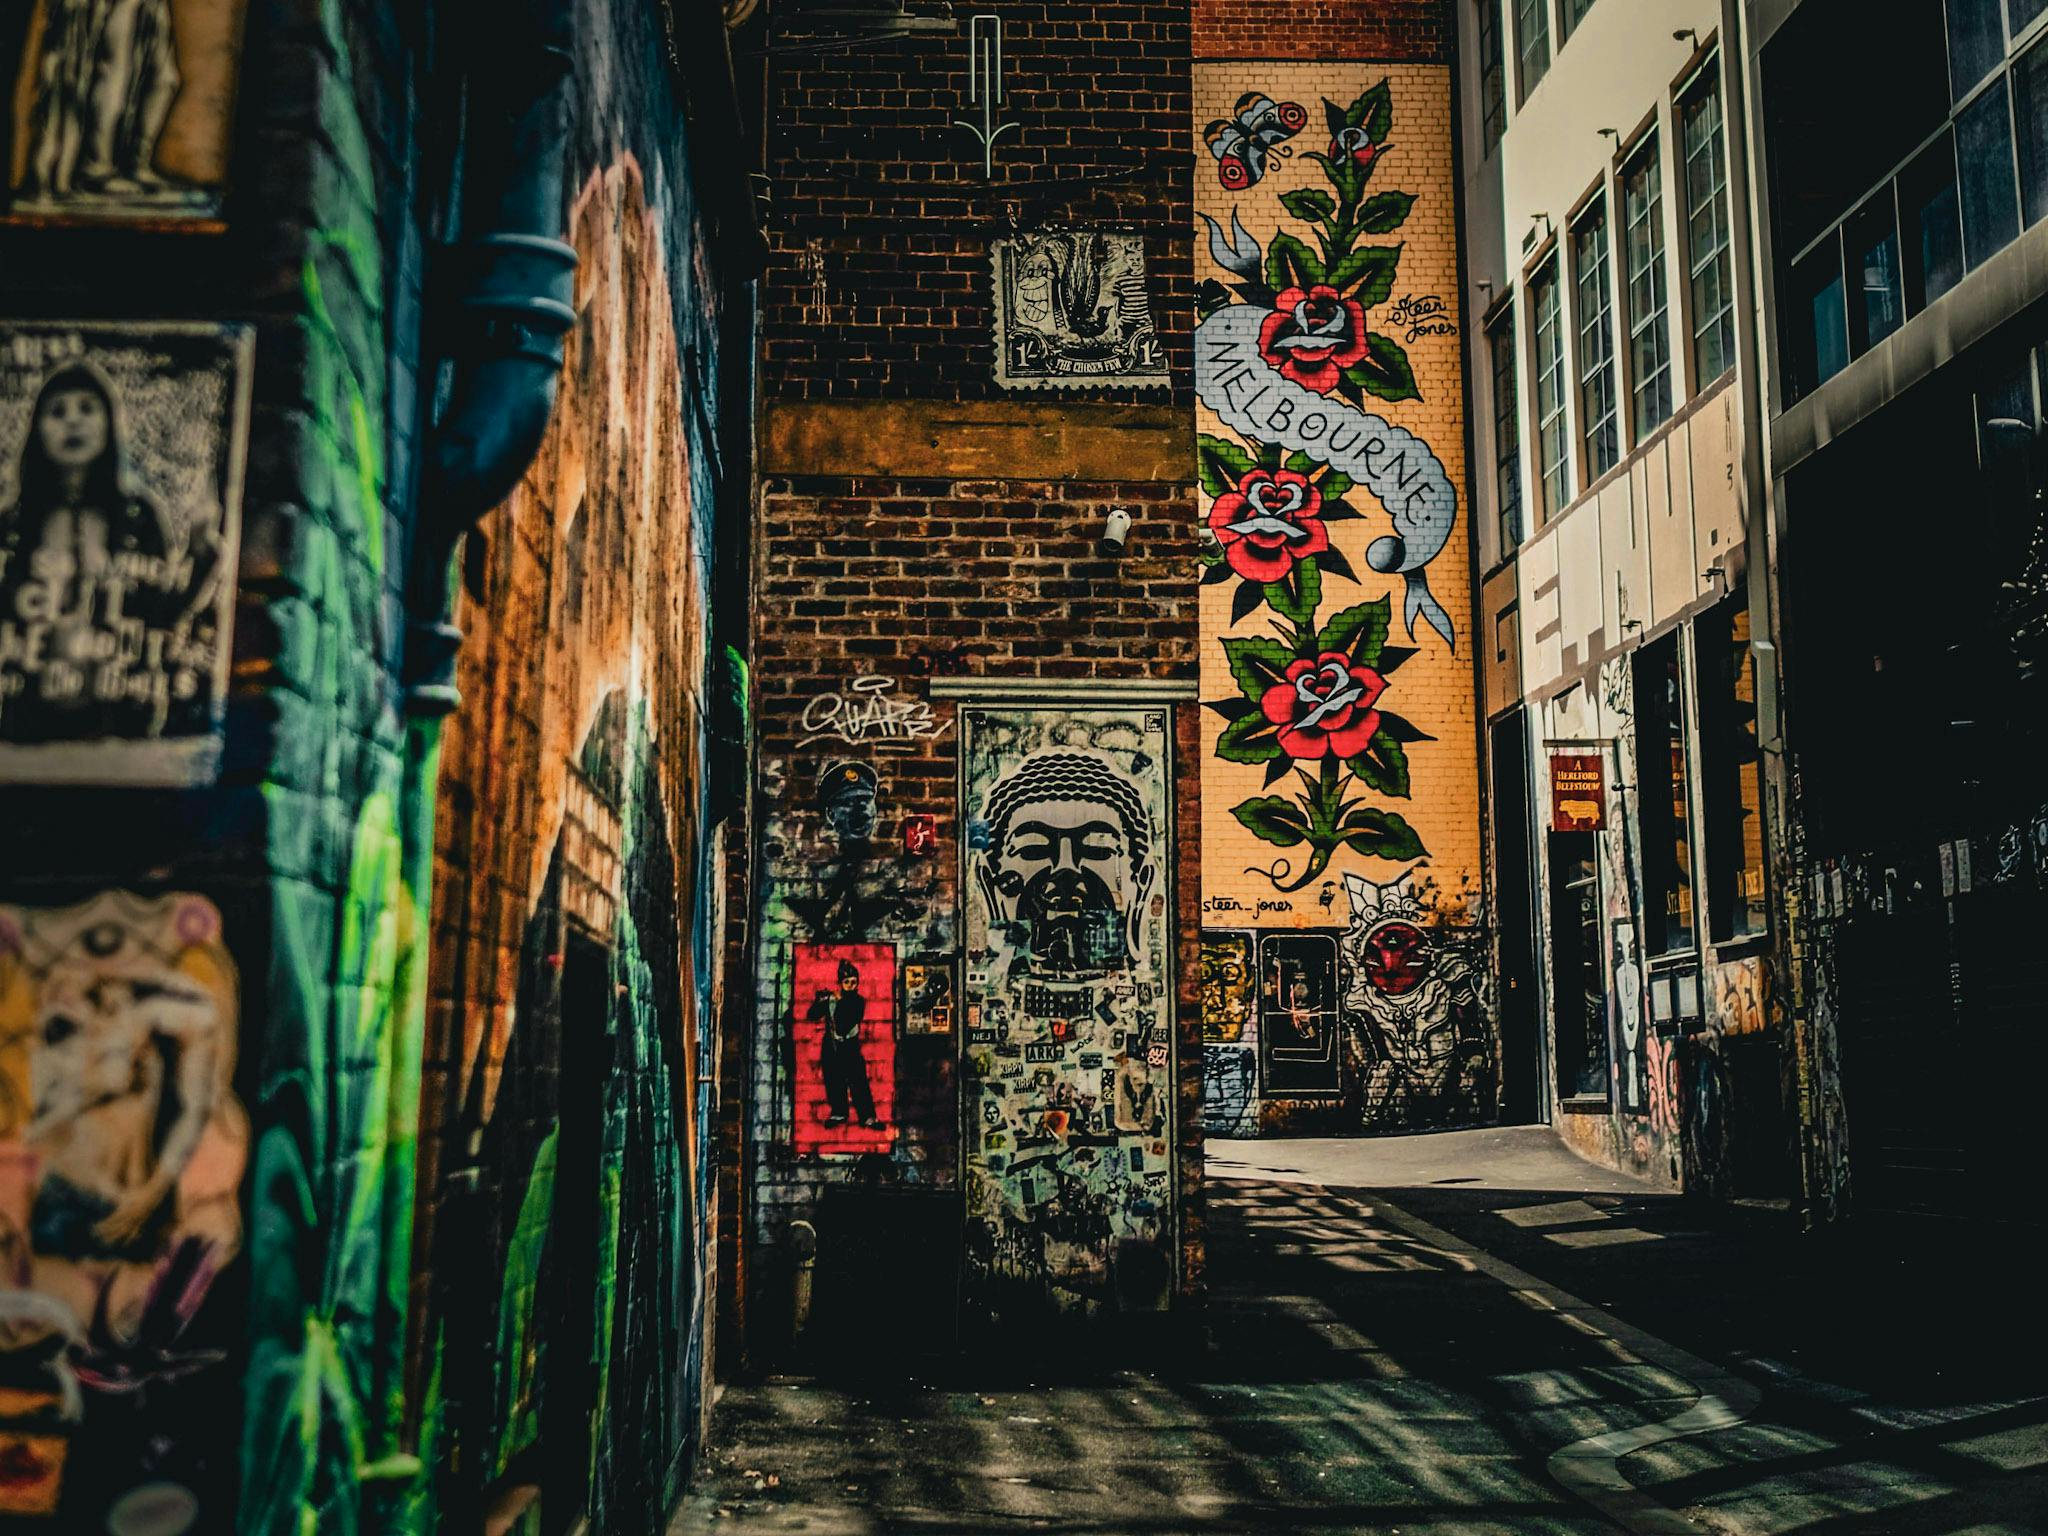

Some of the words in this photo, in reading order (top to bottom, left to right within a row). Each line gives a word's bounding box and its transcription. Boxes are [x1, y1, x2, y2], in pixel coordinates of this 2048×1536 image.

[1384, 293, 1447, 326] Steen
[1406, 315, 1457, 344] Jones
[1206, 342, 1435, 526] MELBOURNE
[1557, 770, 1599, 780] HEREFORD
[1574, 760, 1582, 770] A
